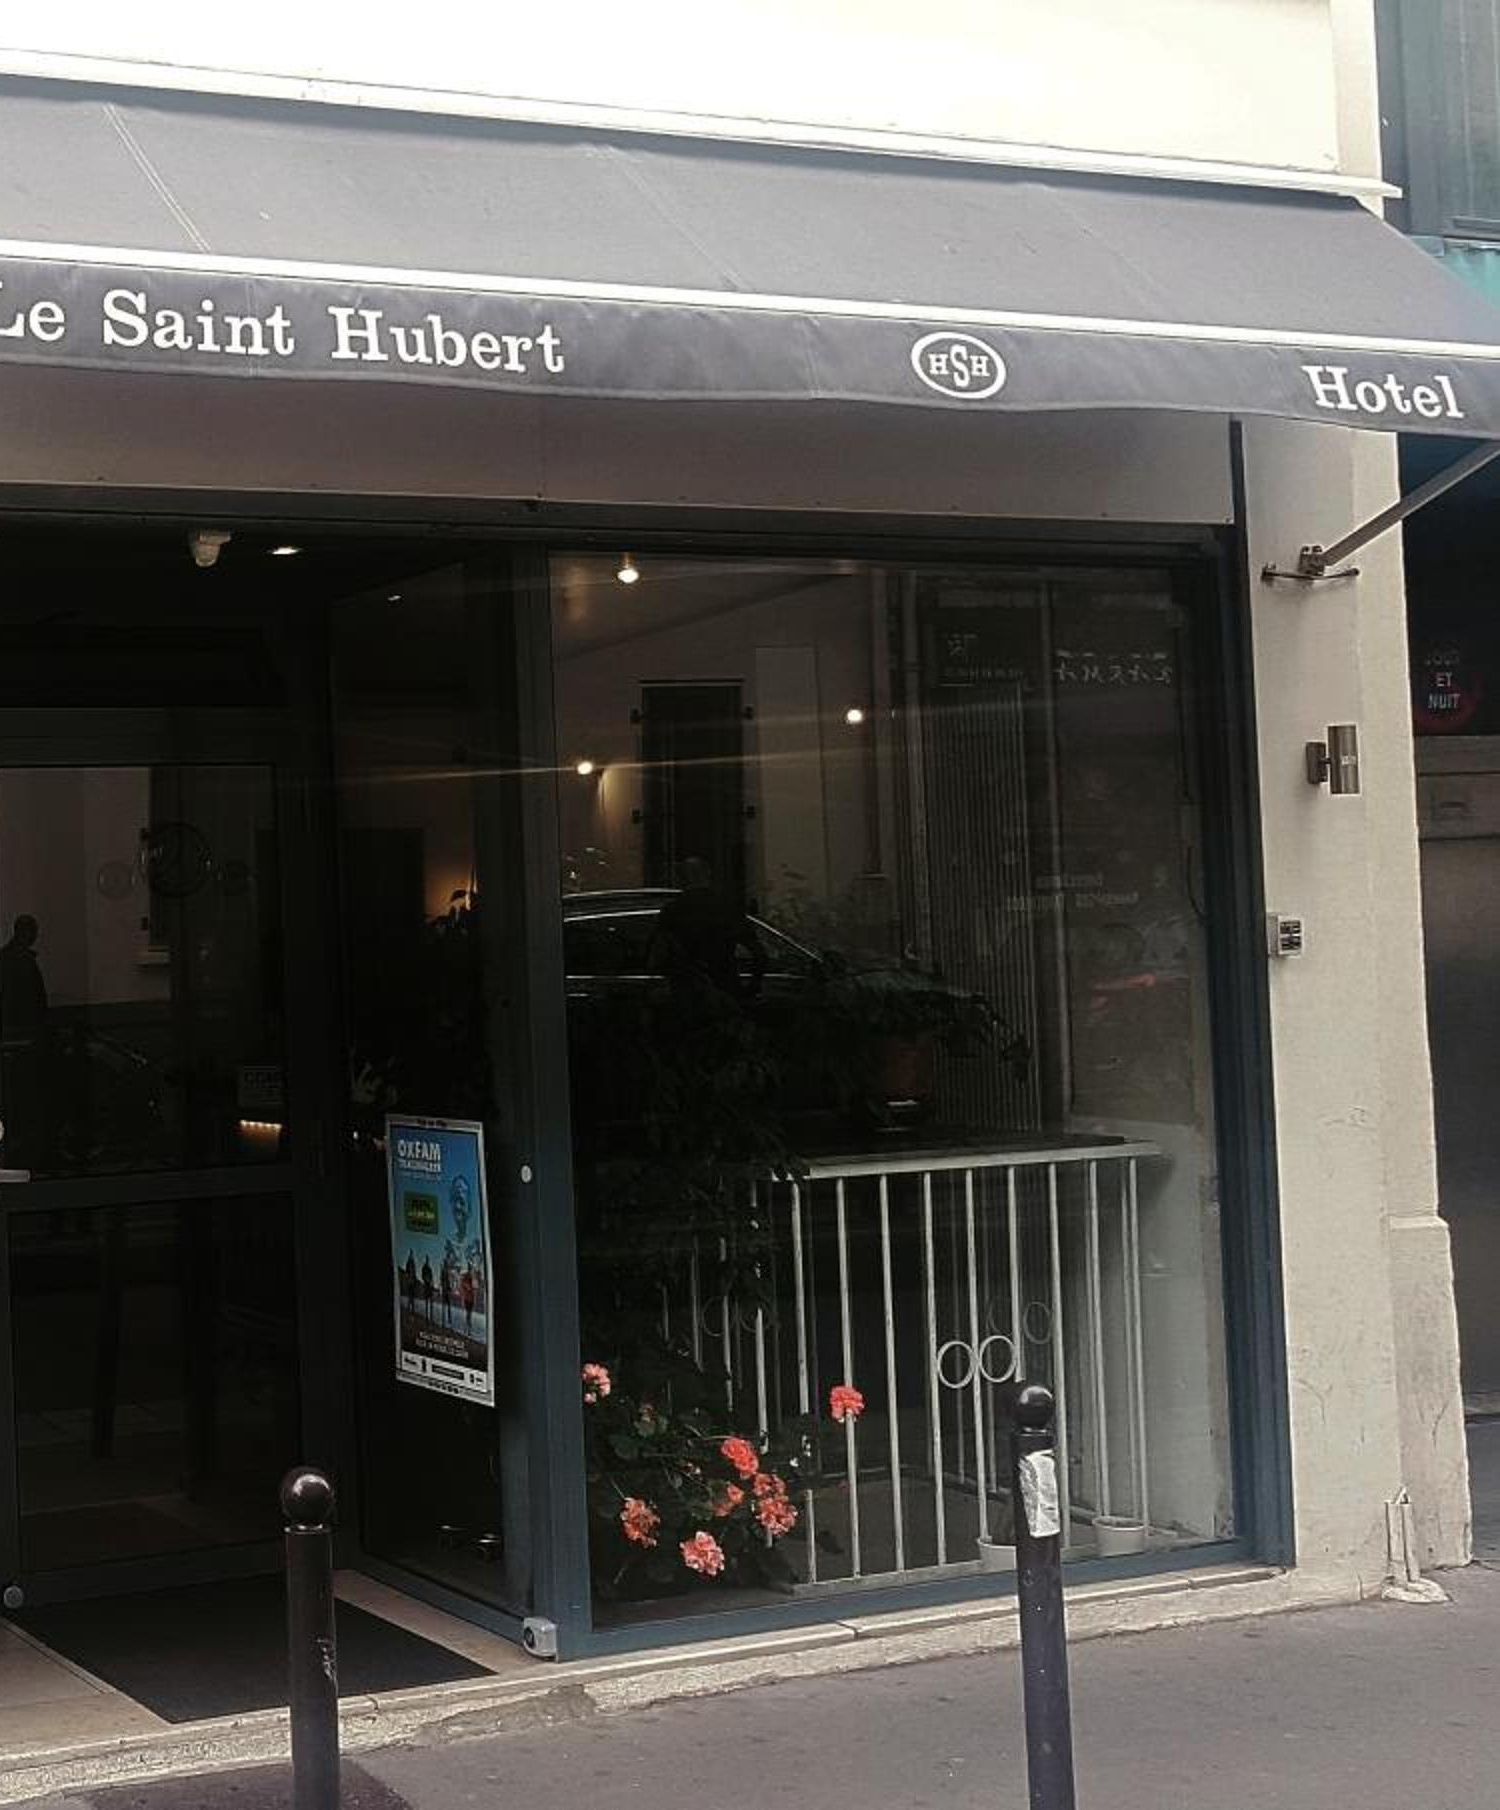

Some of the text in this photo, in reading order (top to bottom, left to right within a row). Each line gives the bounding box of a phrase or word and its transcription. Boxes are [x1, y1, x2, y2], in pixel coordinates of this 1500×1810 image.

[101, 287, 296, 356] Saint
[327, 305, 566, 374] Hubert
[929, 344, 991, 388] HSH
[1300, 364, 1466, 419] Hotel
[1436, 671, 1452, 687] ET
[1428, 693, 1460, 710] NUIT
[397, 1138, 441, 1161] OXFAM
